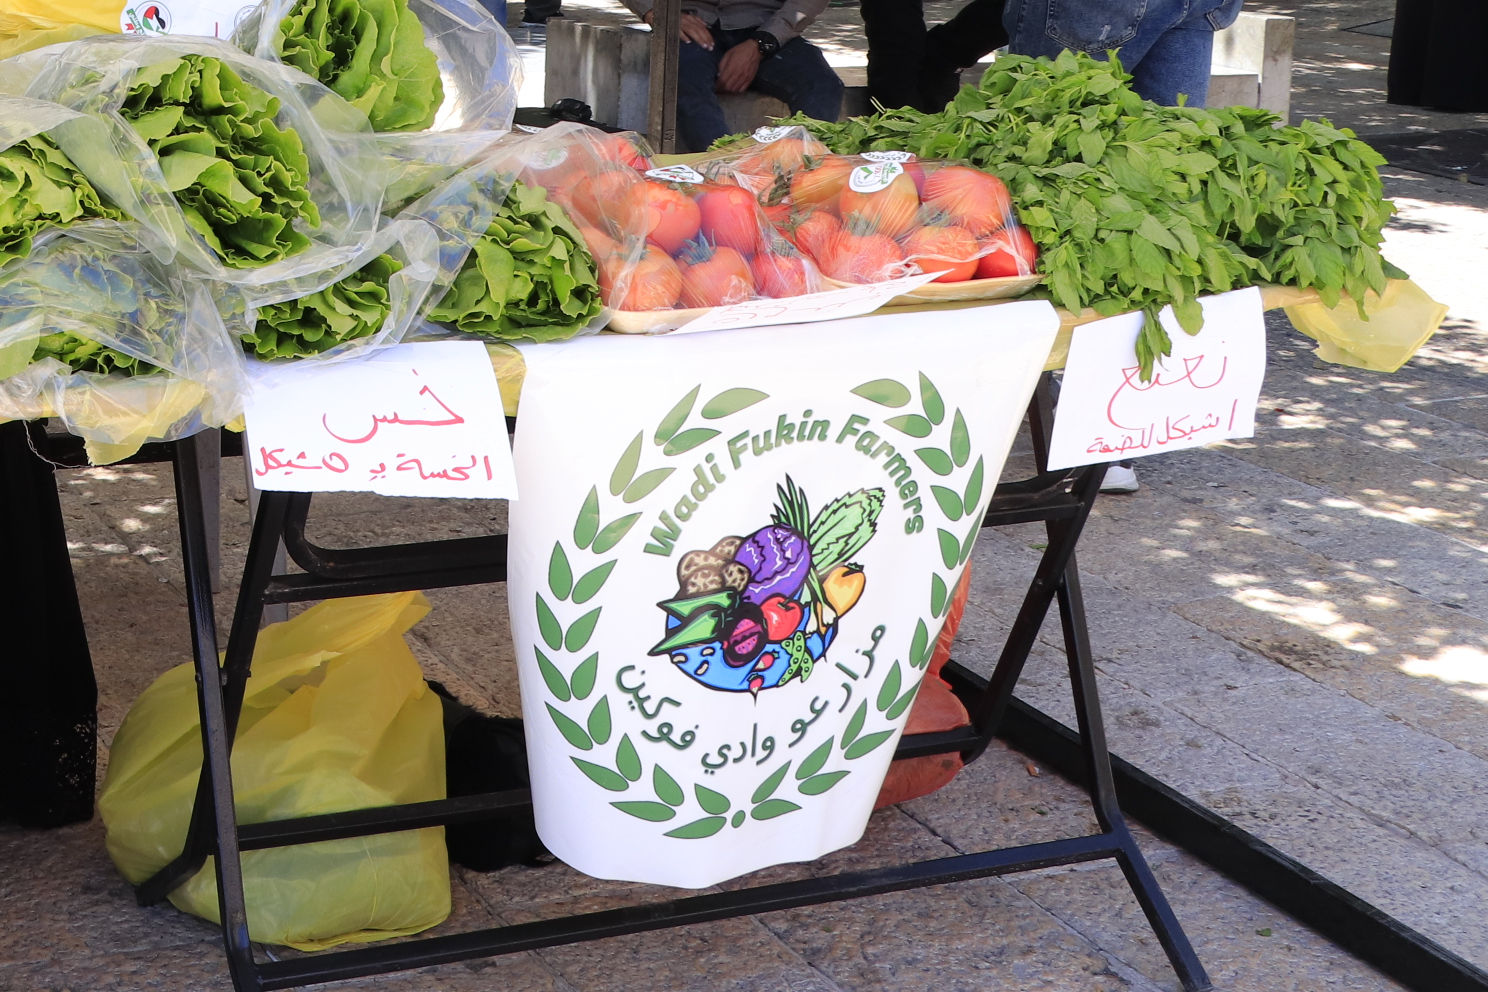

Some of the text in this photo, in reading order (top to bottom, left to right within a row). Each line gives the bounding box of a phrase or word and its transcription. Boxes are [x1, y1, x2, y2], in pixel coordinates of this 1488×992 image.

[322, 368, 465, 444] خس
[1156, 413, 1220, 445] شيكل
[254, 446, 323, 477] شيكل
[643, 409, 925, 558] Wadi Fukin Farmers
[615, 623, 889, 776] مزارعو وادي فوكين
